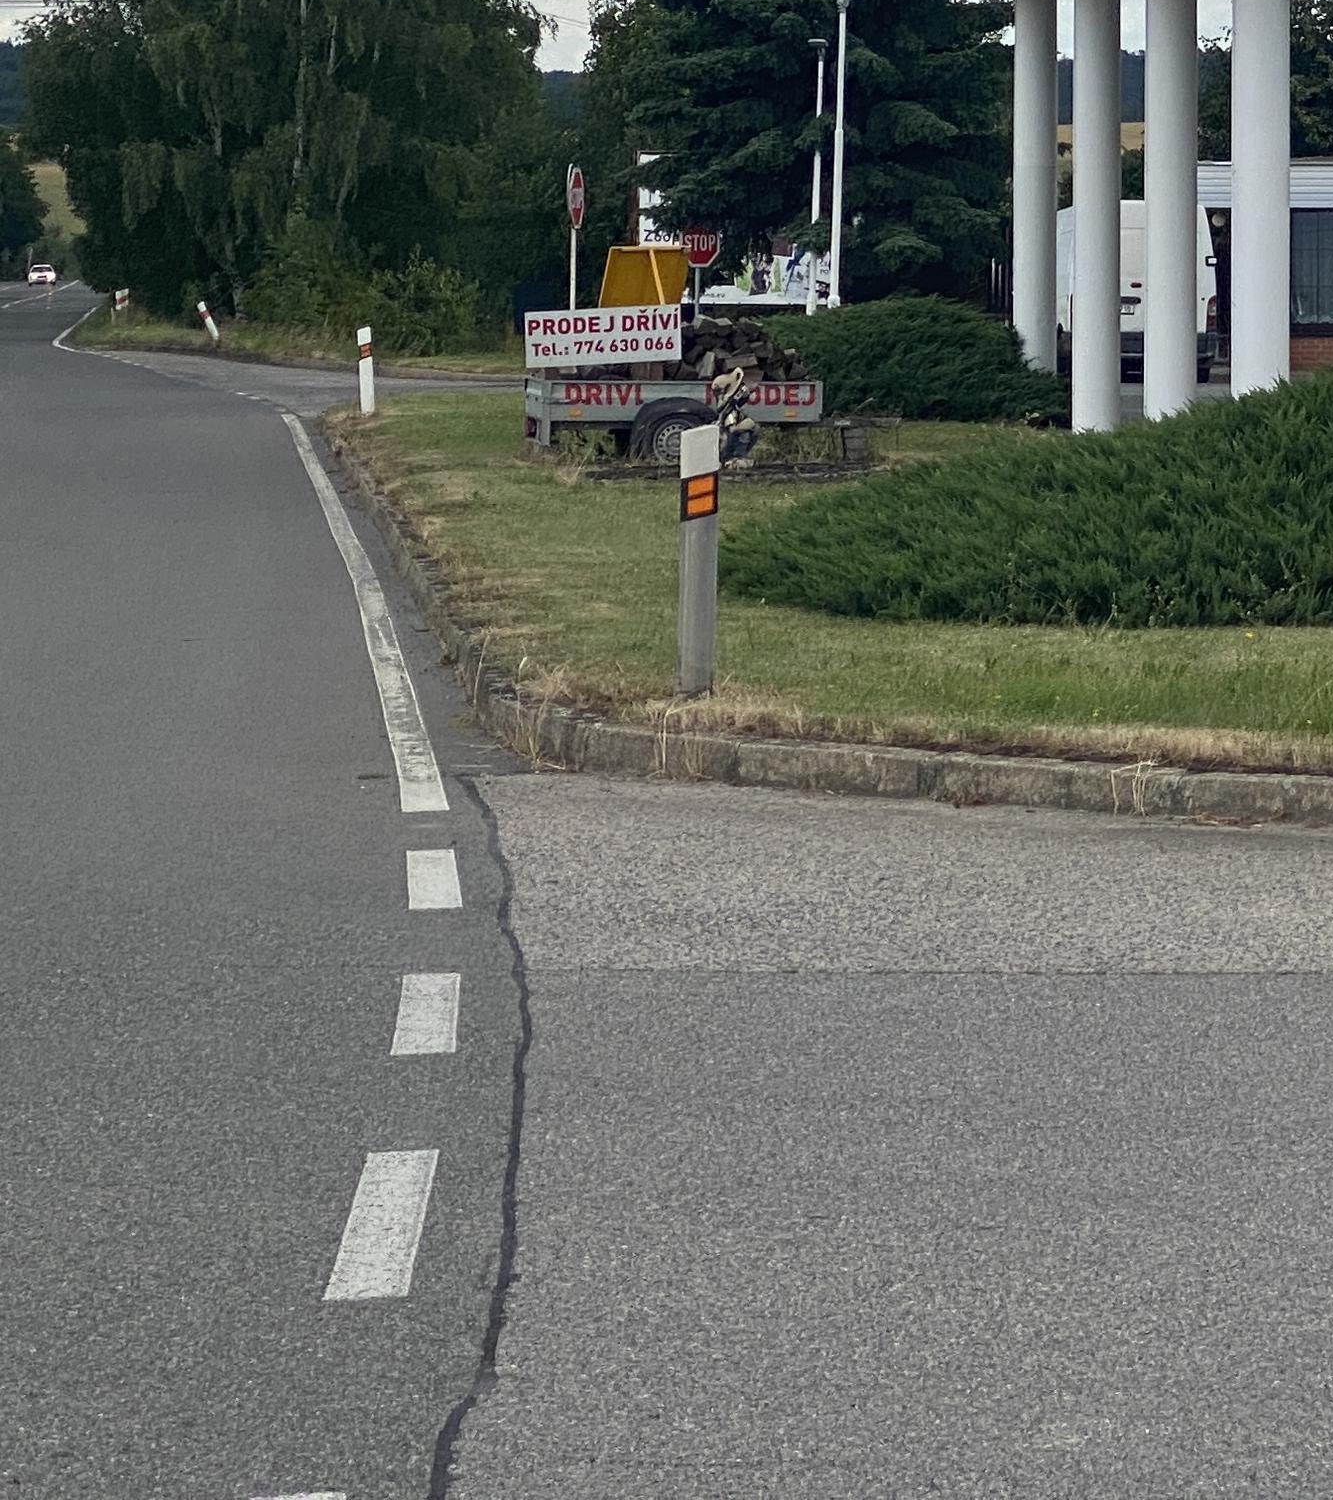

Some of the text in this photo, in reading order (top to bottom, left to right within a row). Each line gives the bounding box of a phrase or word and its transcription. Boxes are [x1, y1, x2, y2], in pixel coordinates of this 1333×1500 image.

[684, 234, 716, 251] STOP
[527, 308, 679, 336] PRODEJ DŘÍVÍ
[574, 340, 605, 355] 774
[609, 338, 639, 353] 630
[644, 336, 674, 351] 066
